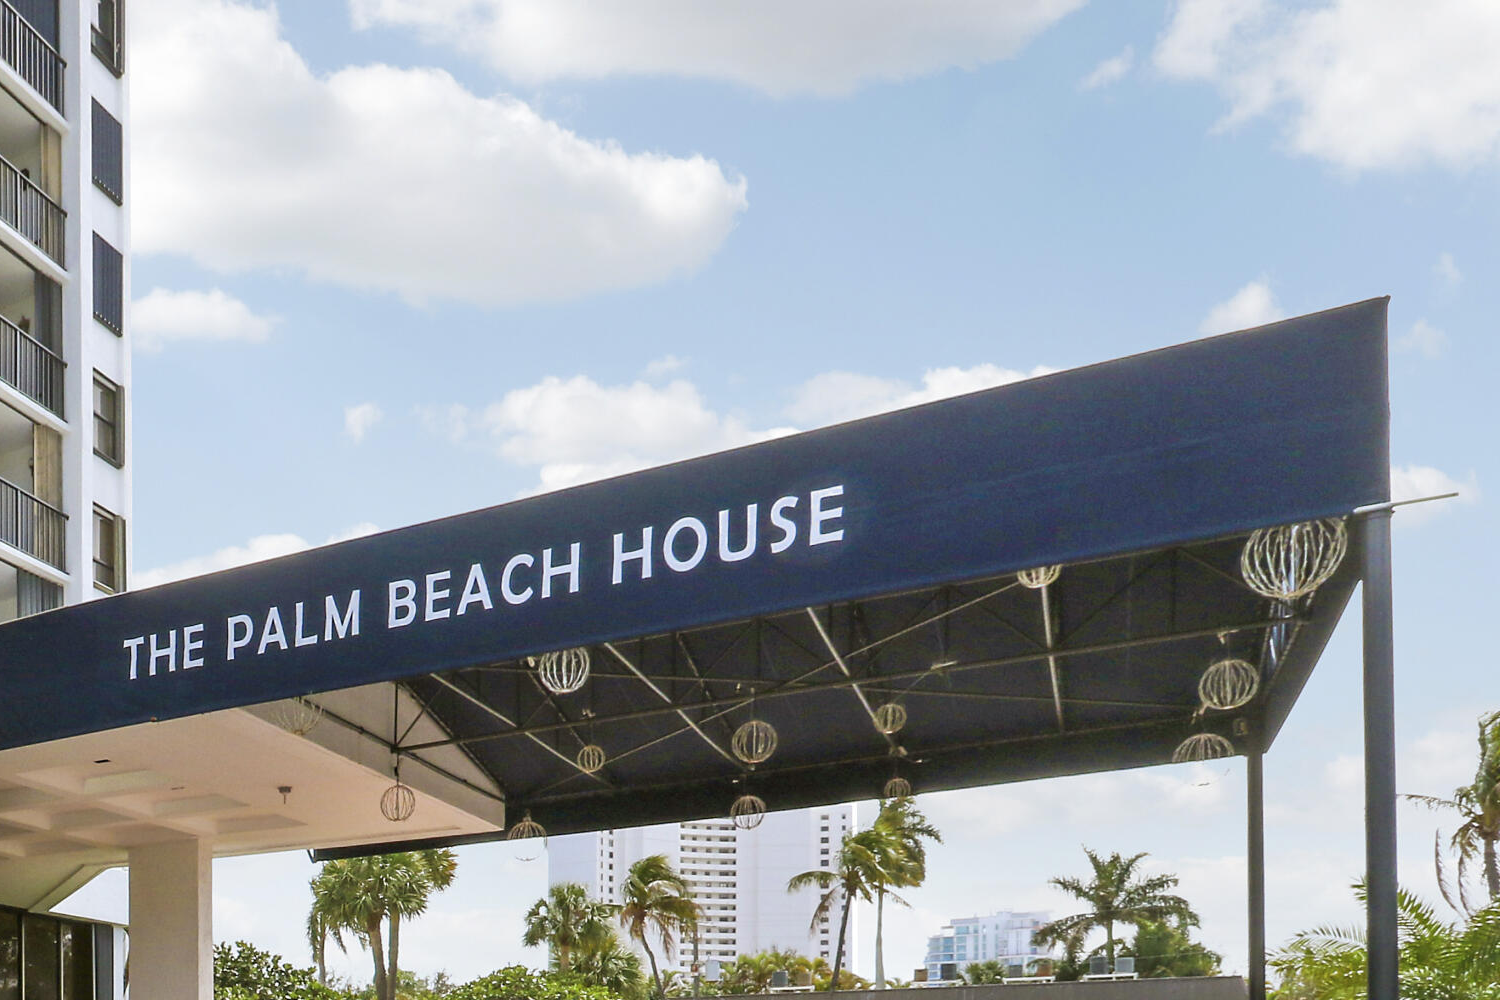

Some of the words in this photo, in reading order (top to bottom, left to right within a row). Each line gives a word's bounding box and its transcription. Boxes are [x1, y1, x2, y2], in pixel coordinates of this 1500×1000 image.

[123, 623, 204, 680] THE
[227, 589, 361, 661] PALM
[387, 541, 581, 629] BEACH
[611, 484, 845, 585] HOUSE
